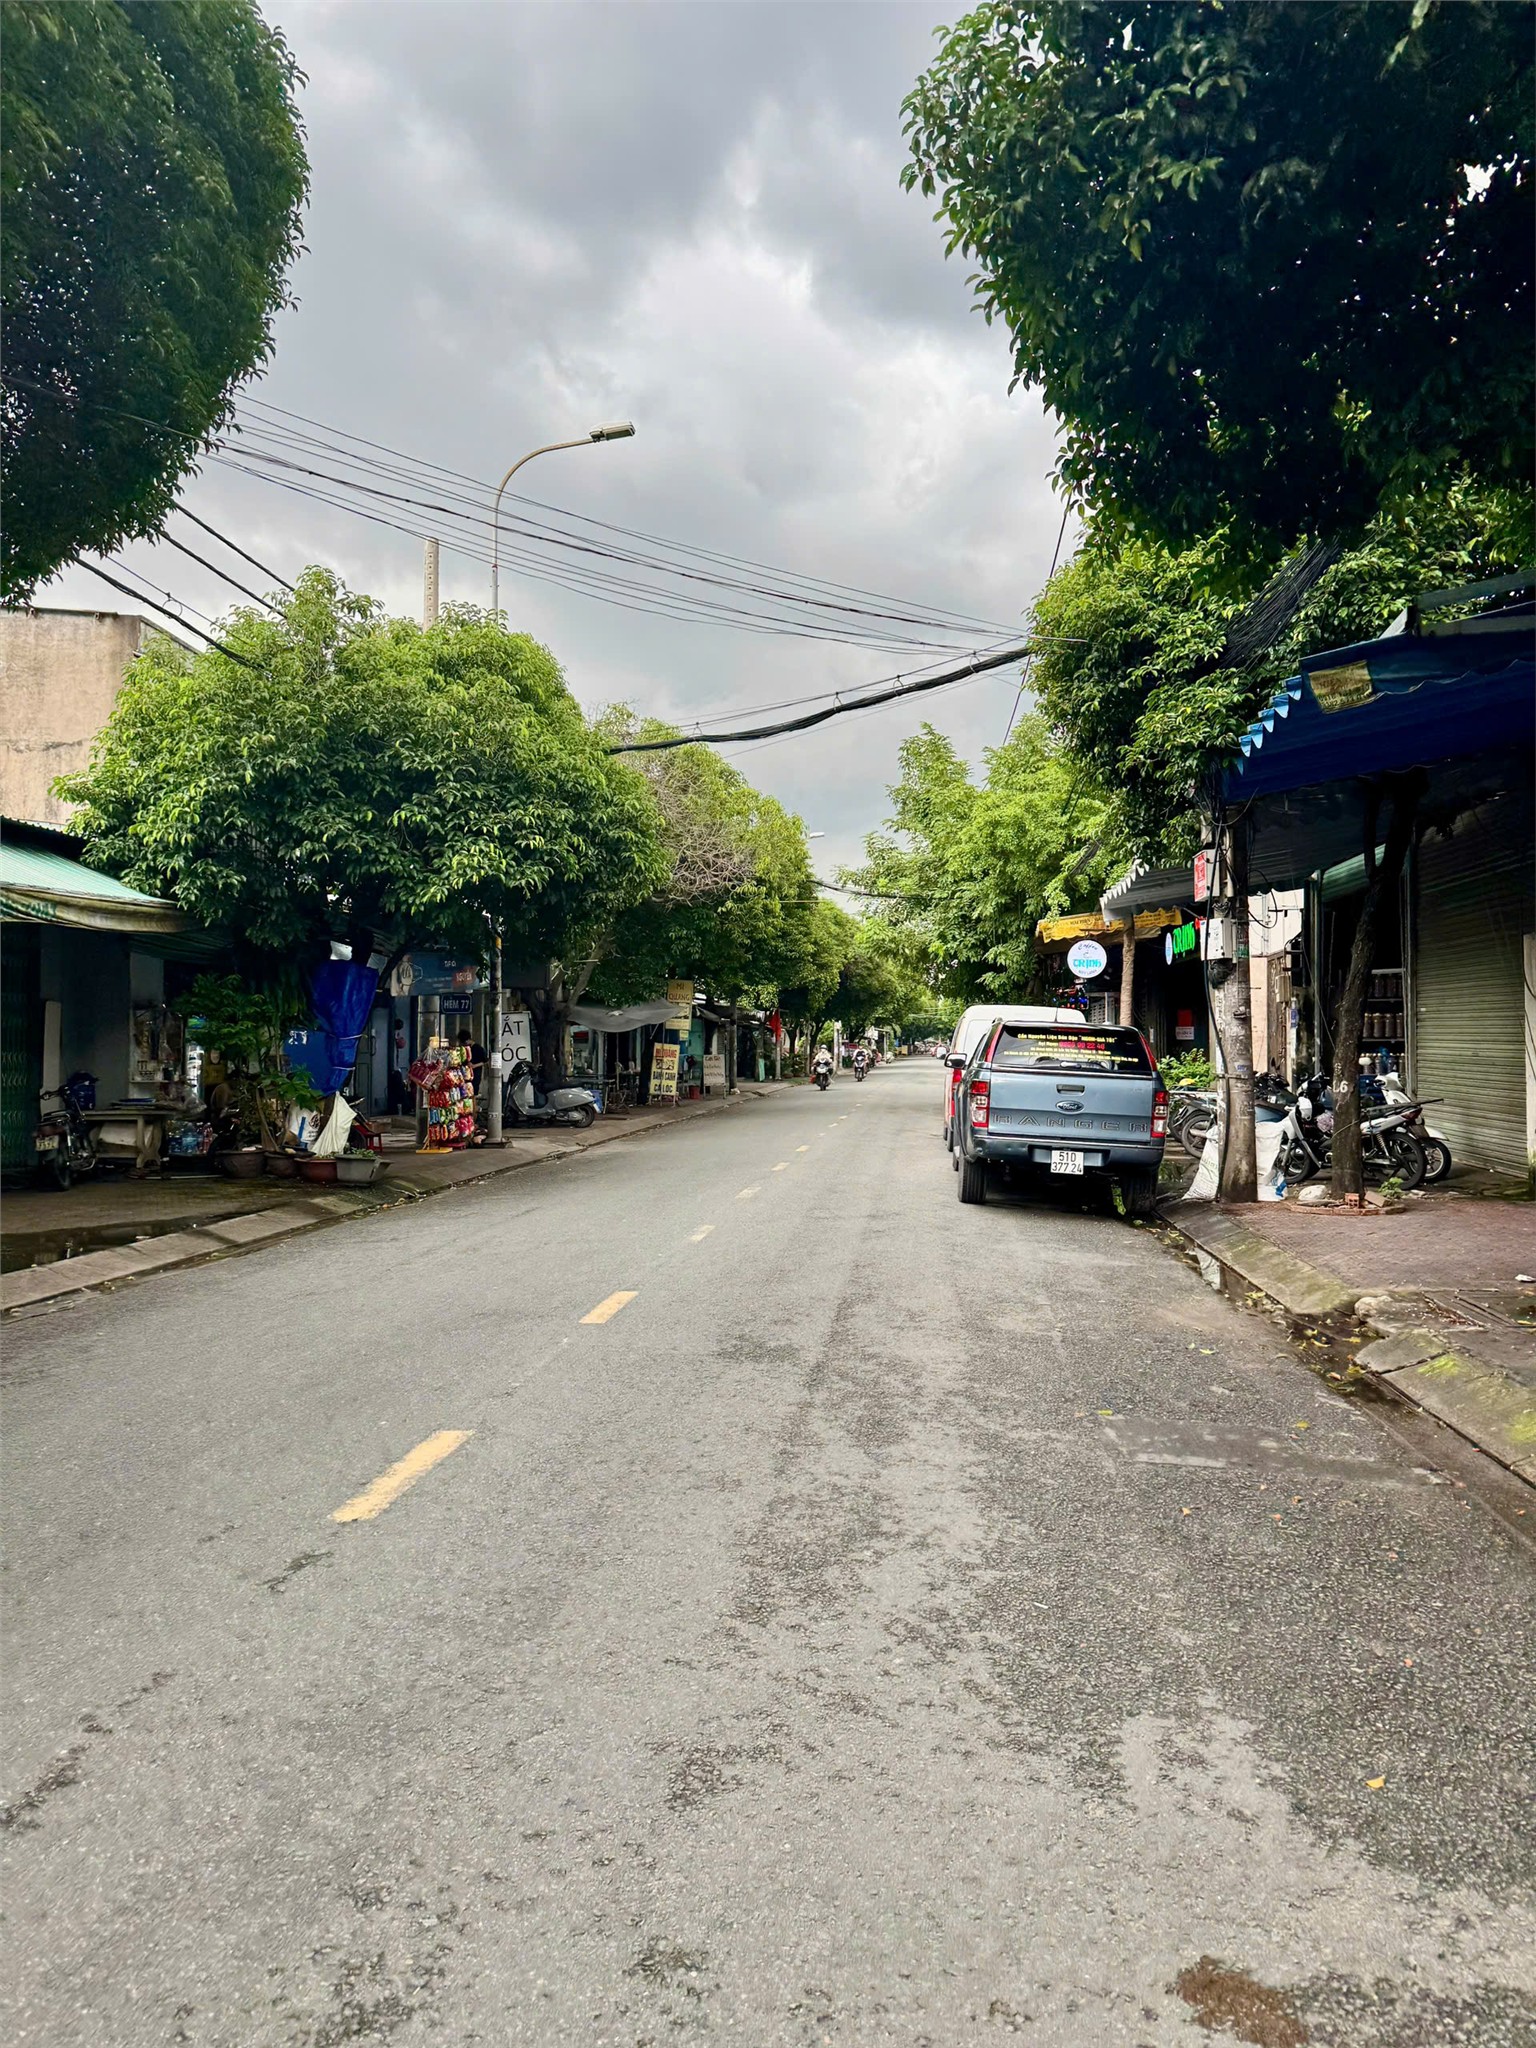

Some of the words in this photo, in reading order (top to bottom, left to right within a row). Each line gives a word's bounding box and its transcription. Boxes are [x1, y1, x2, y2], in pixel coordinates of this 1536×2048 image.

[460, 999, 470, 1009] 77
[501, 1016, 524, 1036] ẮT
[501, 1043, 527, 1062] ÓC
[992, 1113, 1148, 1132] RANGER
[1059, 1152, 1077, 1162] 51D
[1052, 1162, 1082, 1173] 377.24
